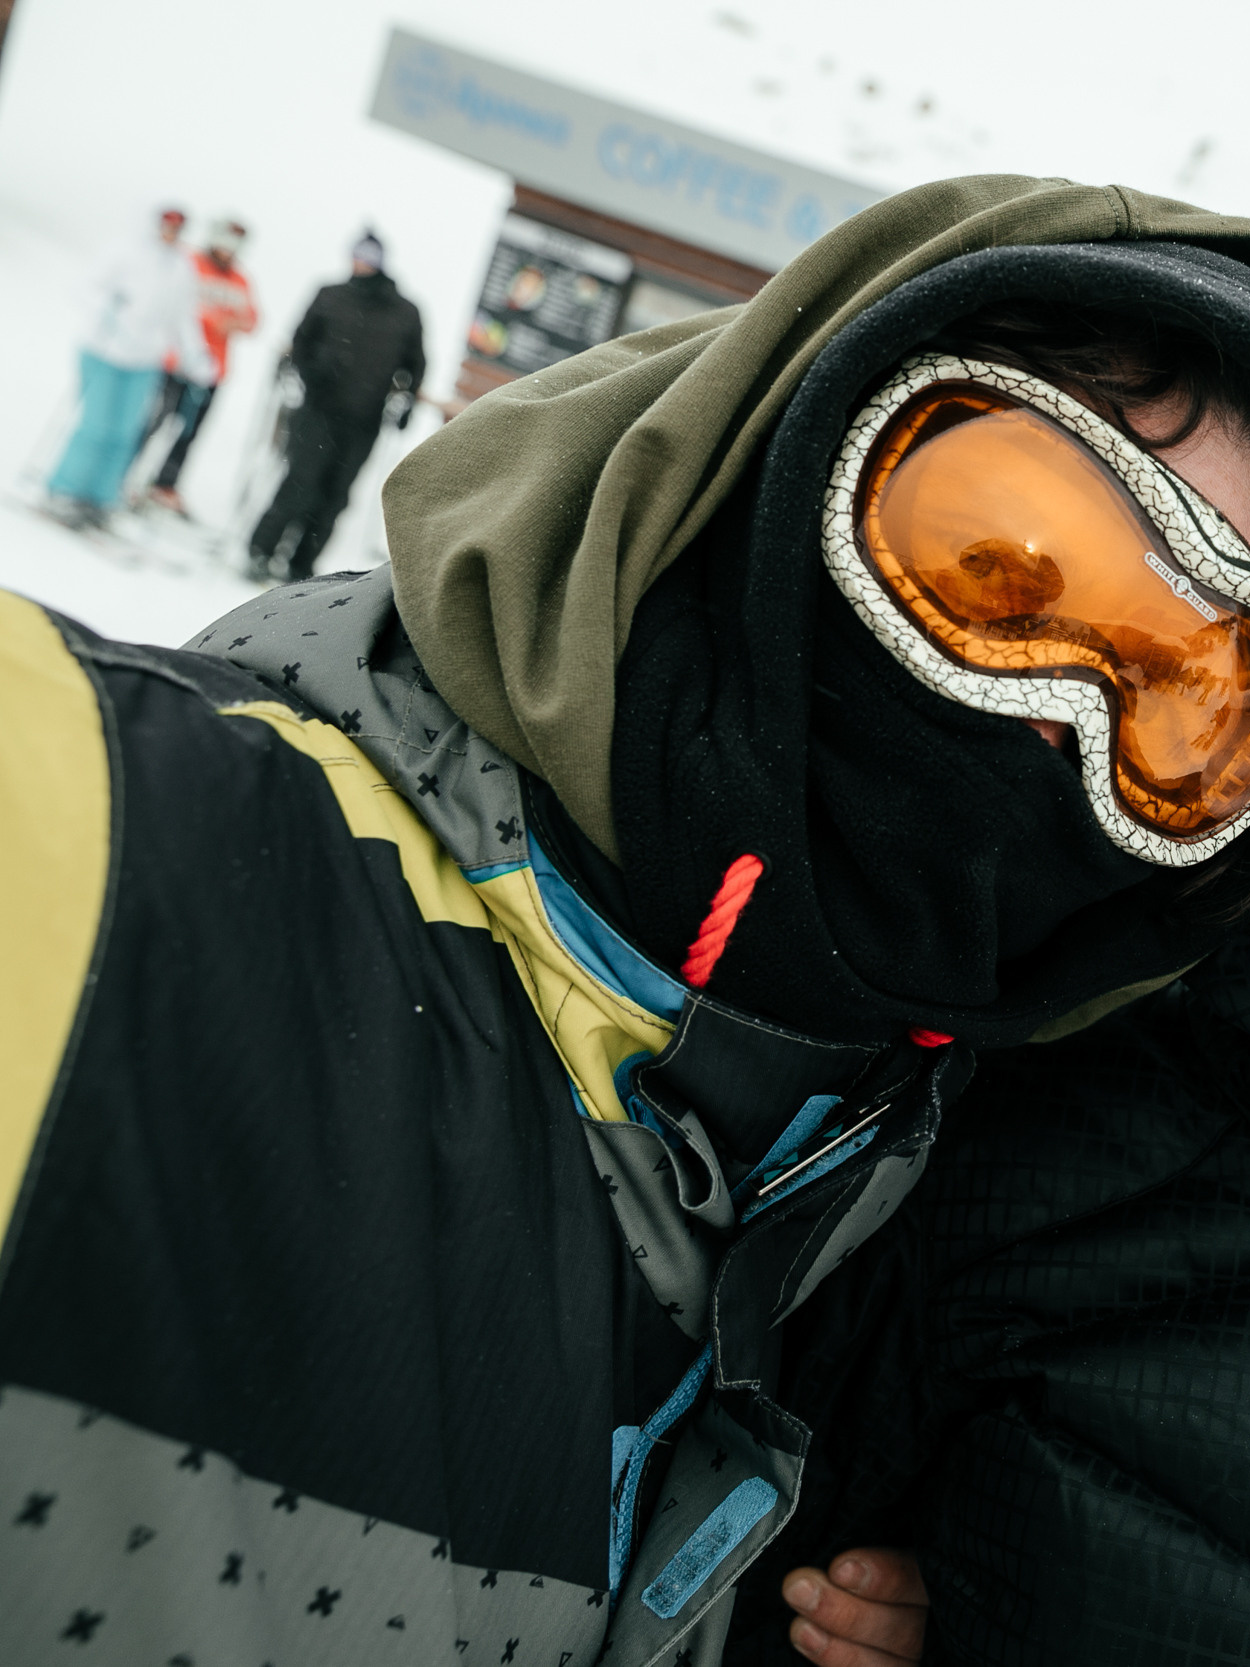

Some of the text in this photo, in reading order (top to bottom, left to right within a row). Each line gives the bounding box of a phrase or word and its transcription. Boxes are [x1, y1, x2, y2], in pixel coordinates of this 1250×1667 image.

[599, 122, 784, 230] COFFEE
[1149, 555, 1215, 619] WHITE GUARD
